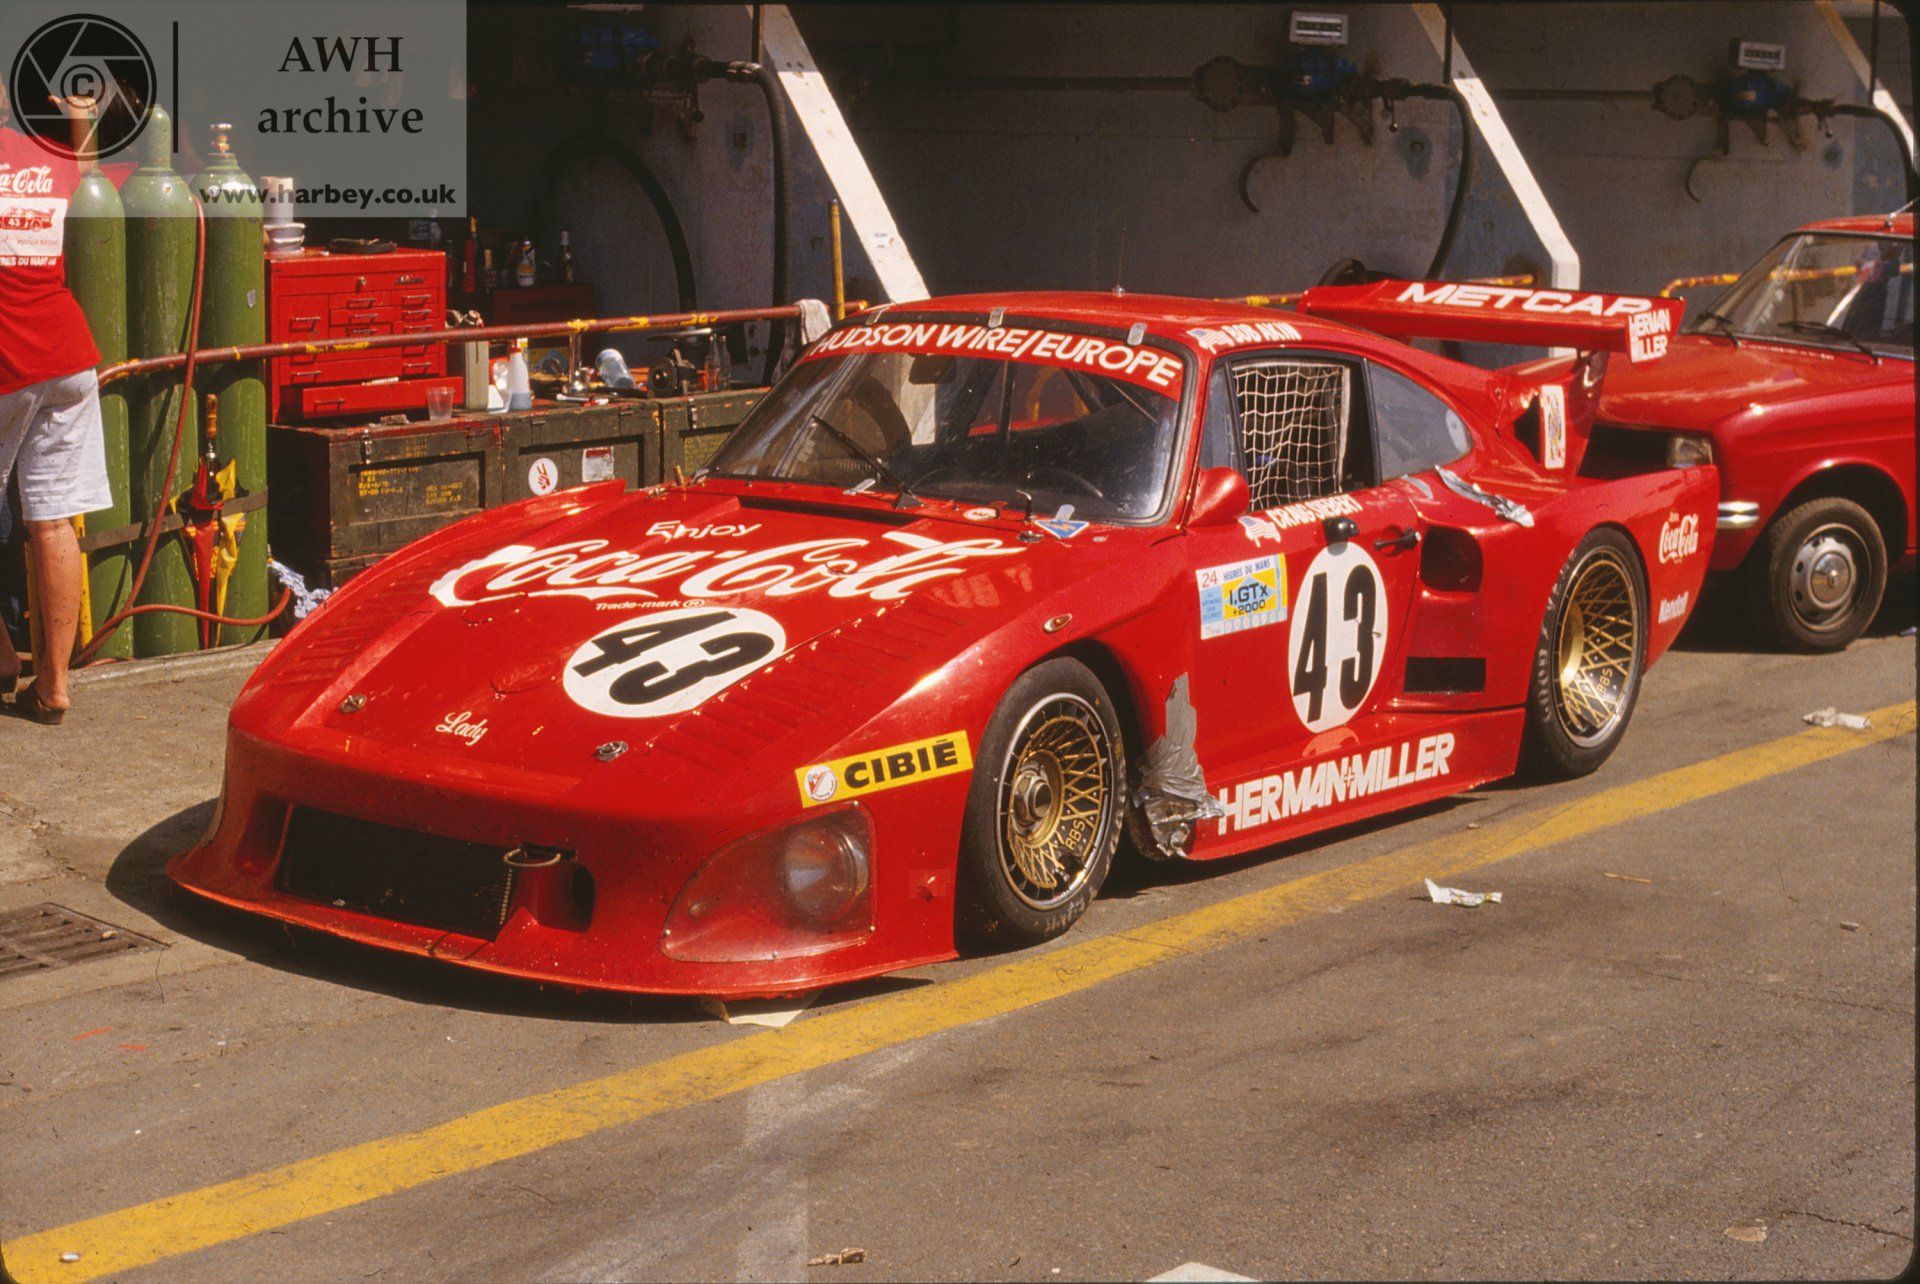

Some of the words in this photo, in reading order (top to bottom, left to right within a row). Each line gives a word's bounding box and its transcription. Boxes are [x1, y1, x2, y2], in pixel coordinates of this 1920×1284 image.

[1397, 283, 1652, 316] METCAP
[811, 323, 937, 356] HUDSON
[936, 326, 1182, 386] WIRE/EUROPE
[645, 519, 763, 543] Enjoy
[428, 531, 1028, 608] Coca-Cola
[1202, 570, 1219, 588] 24
[595, 600, 680, 611] Trade-mark
[572, 612, 775, 705] 43
[1292, 564, 1378, 723] 43
[435, 711, 488, 746] Lady
[1218, 762, 1349, 836] HERMAN
[1350, 732, 1456, 799] MILLER
